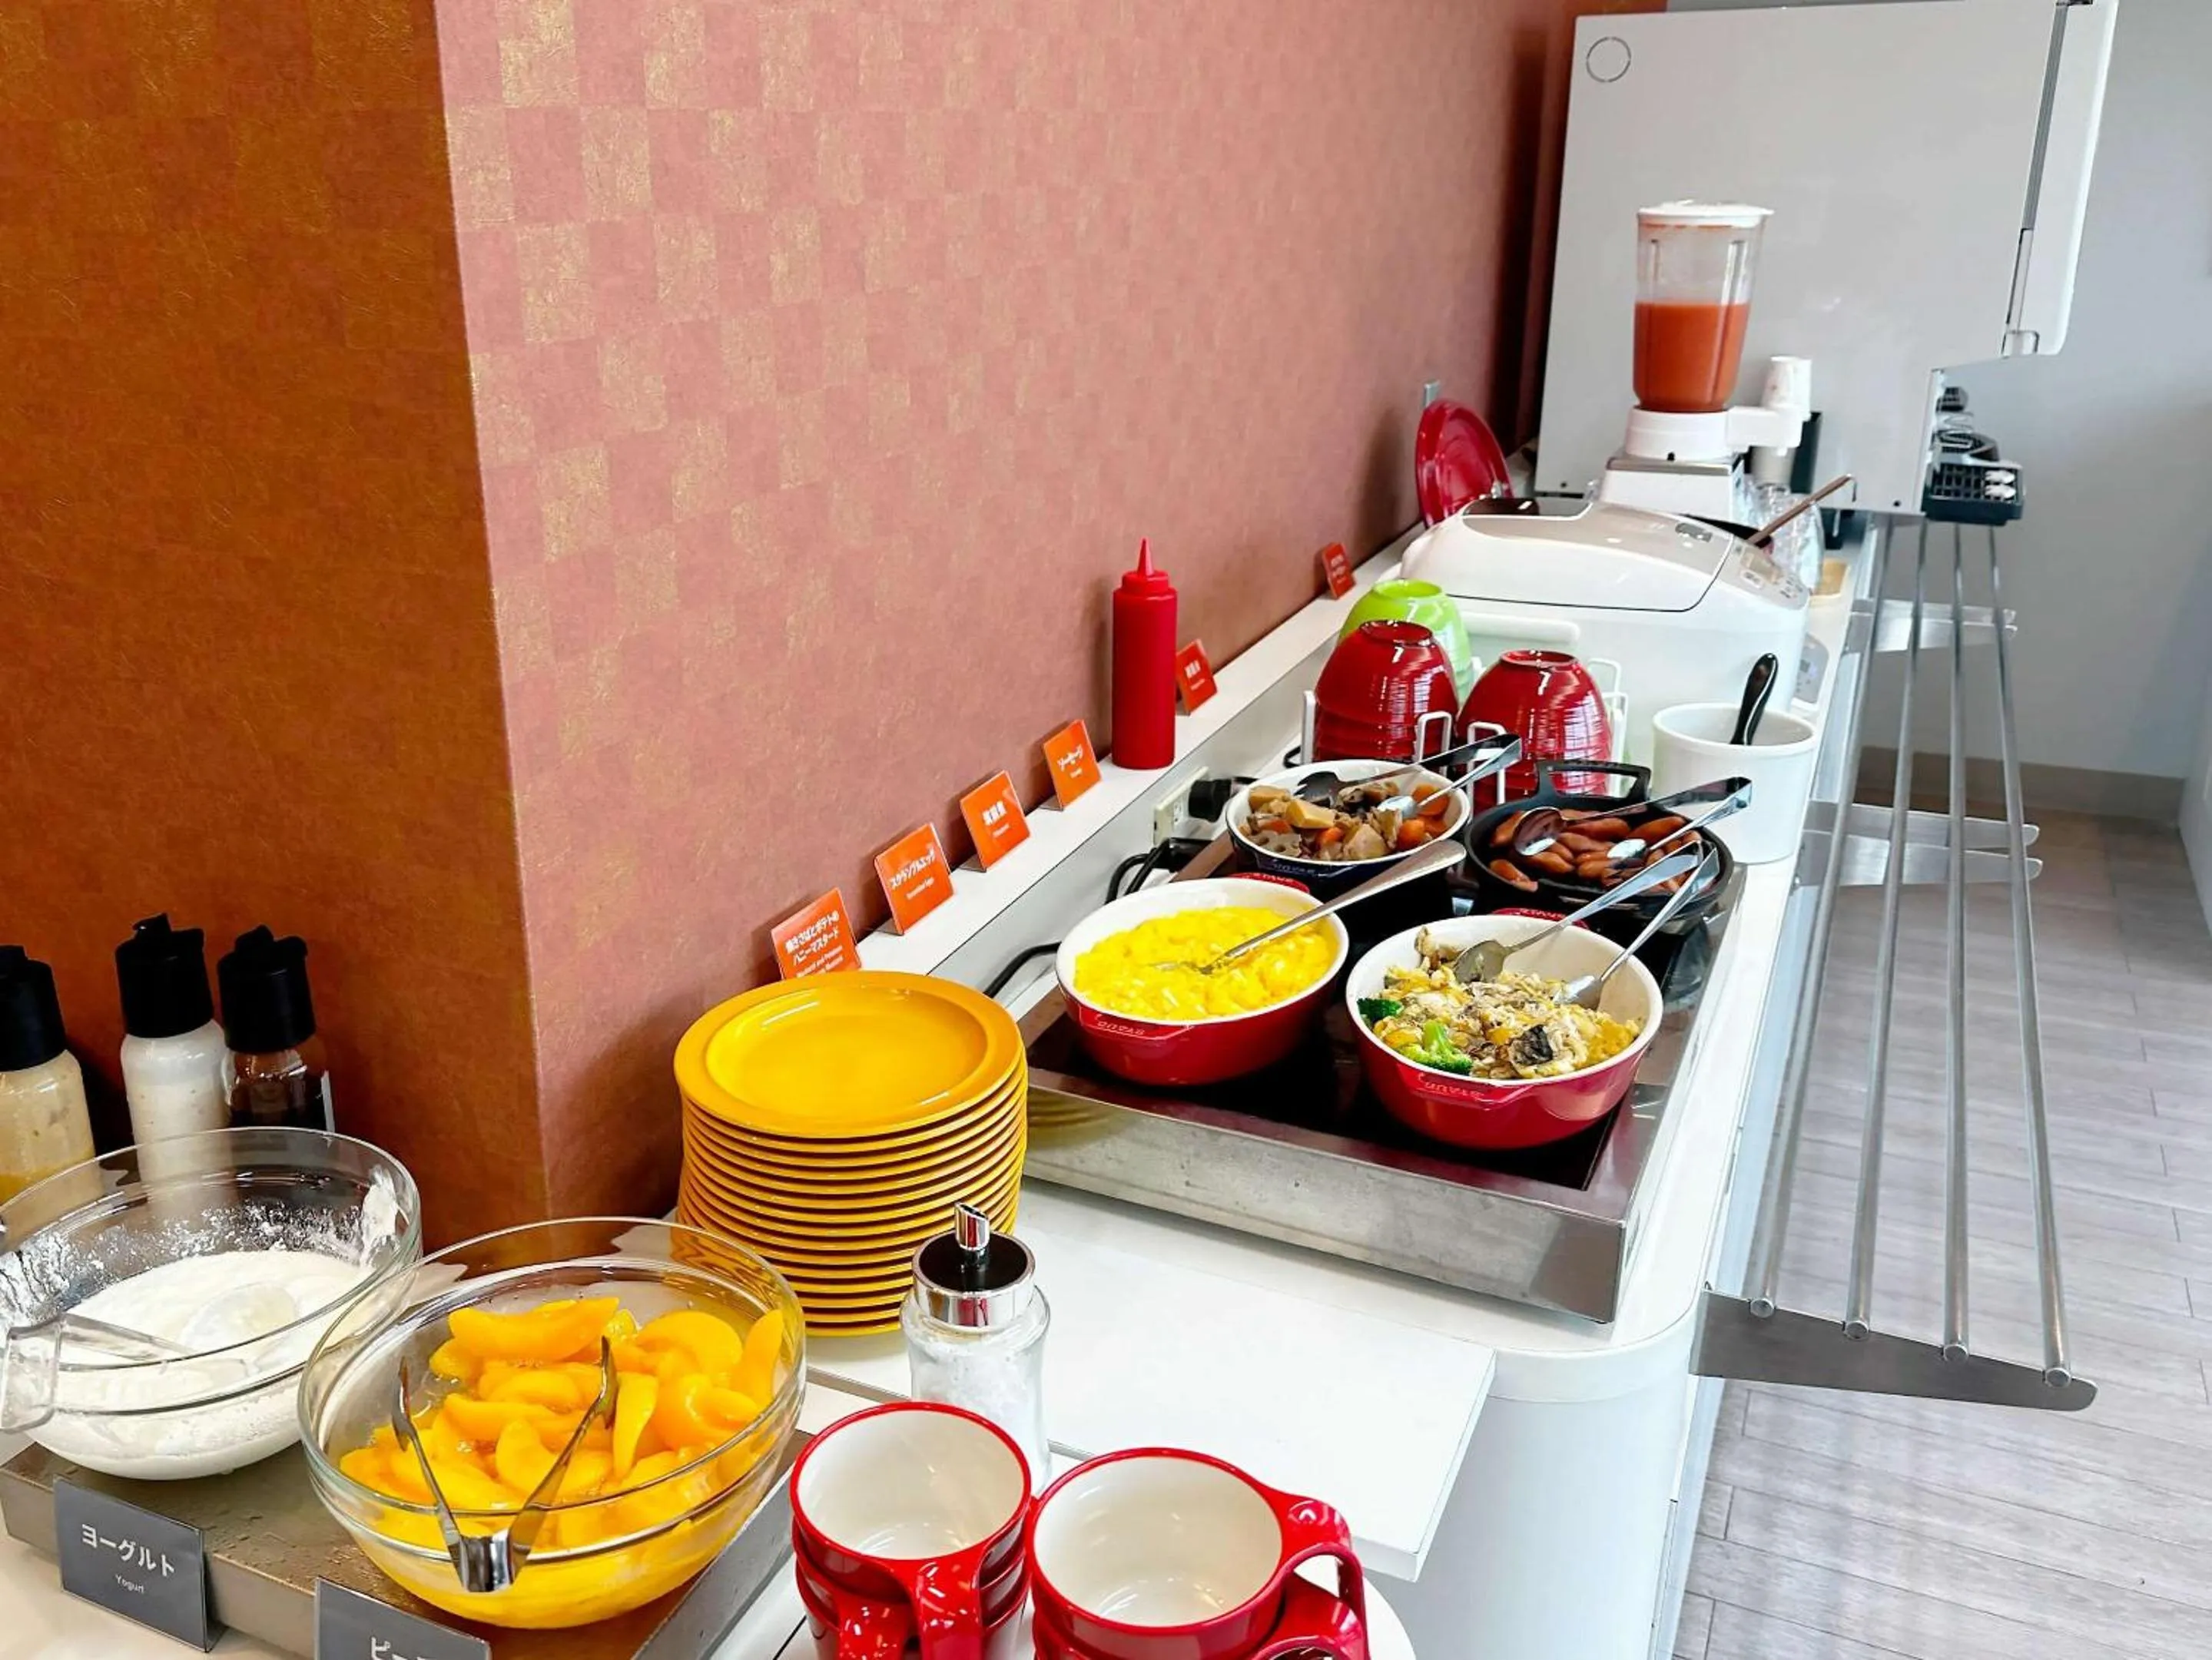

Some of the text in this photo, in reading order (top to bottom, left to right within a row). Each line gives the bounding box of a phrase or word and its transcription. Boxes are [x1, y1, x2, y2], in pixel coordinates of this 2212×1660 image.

[81, 1522, 175, 1578] ヨーグルト
[114, 1574, 144, 1595] Yogurt
